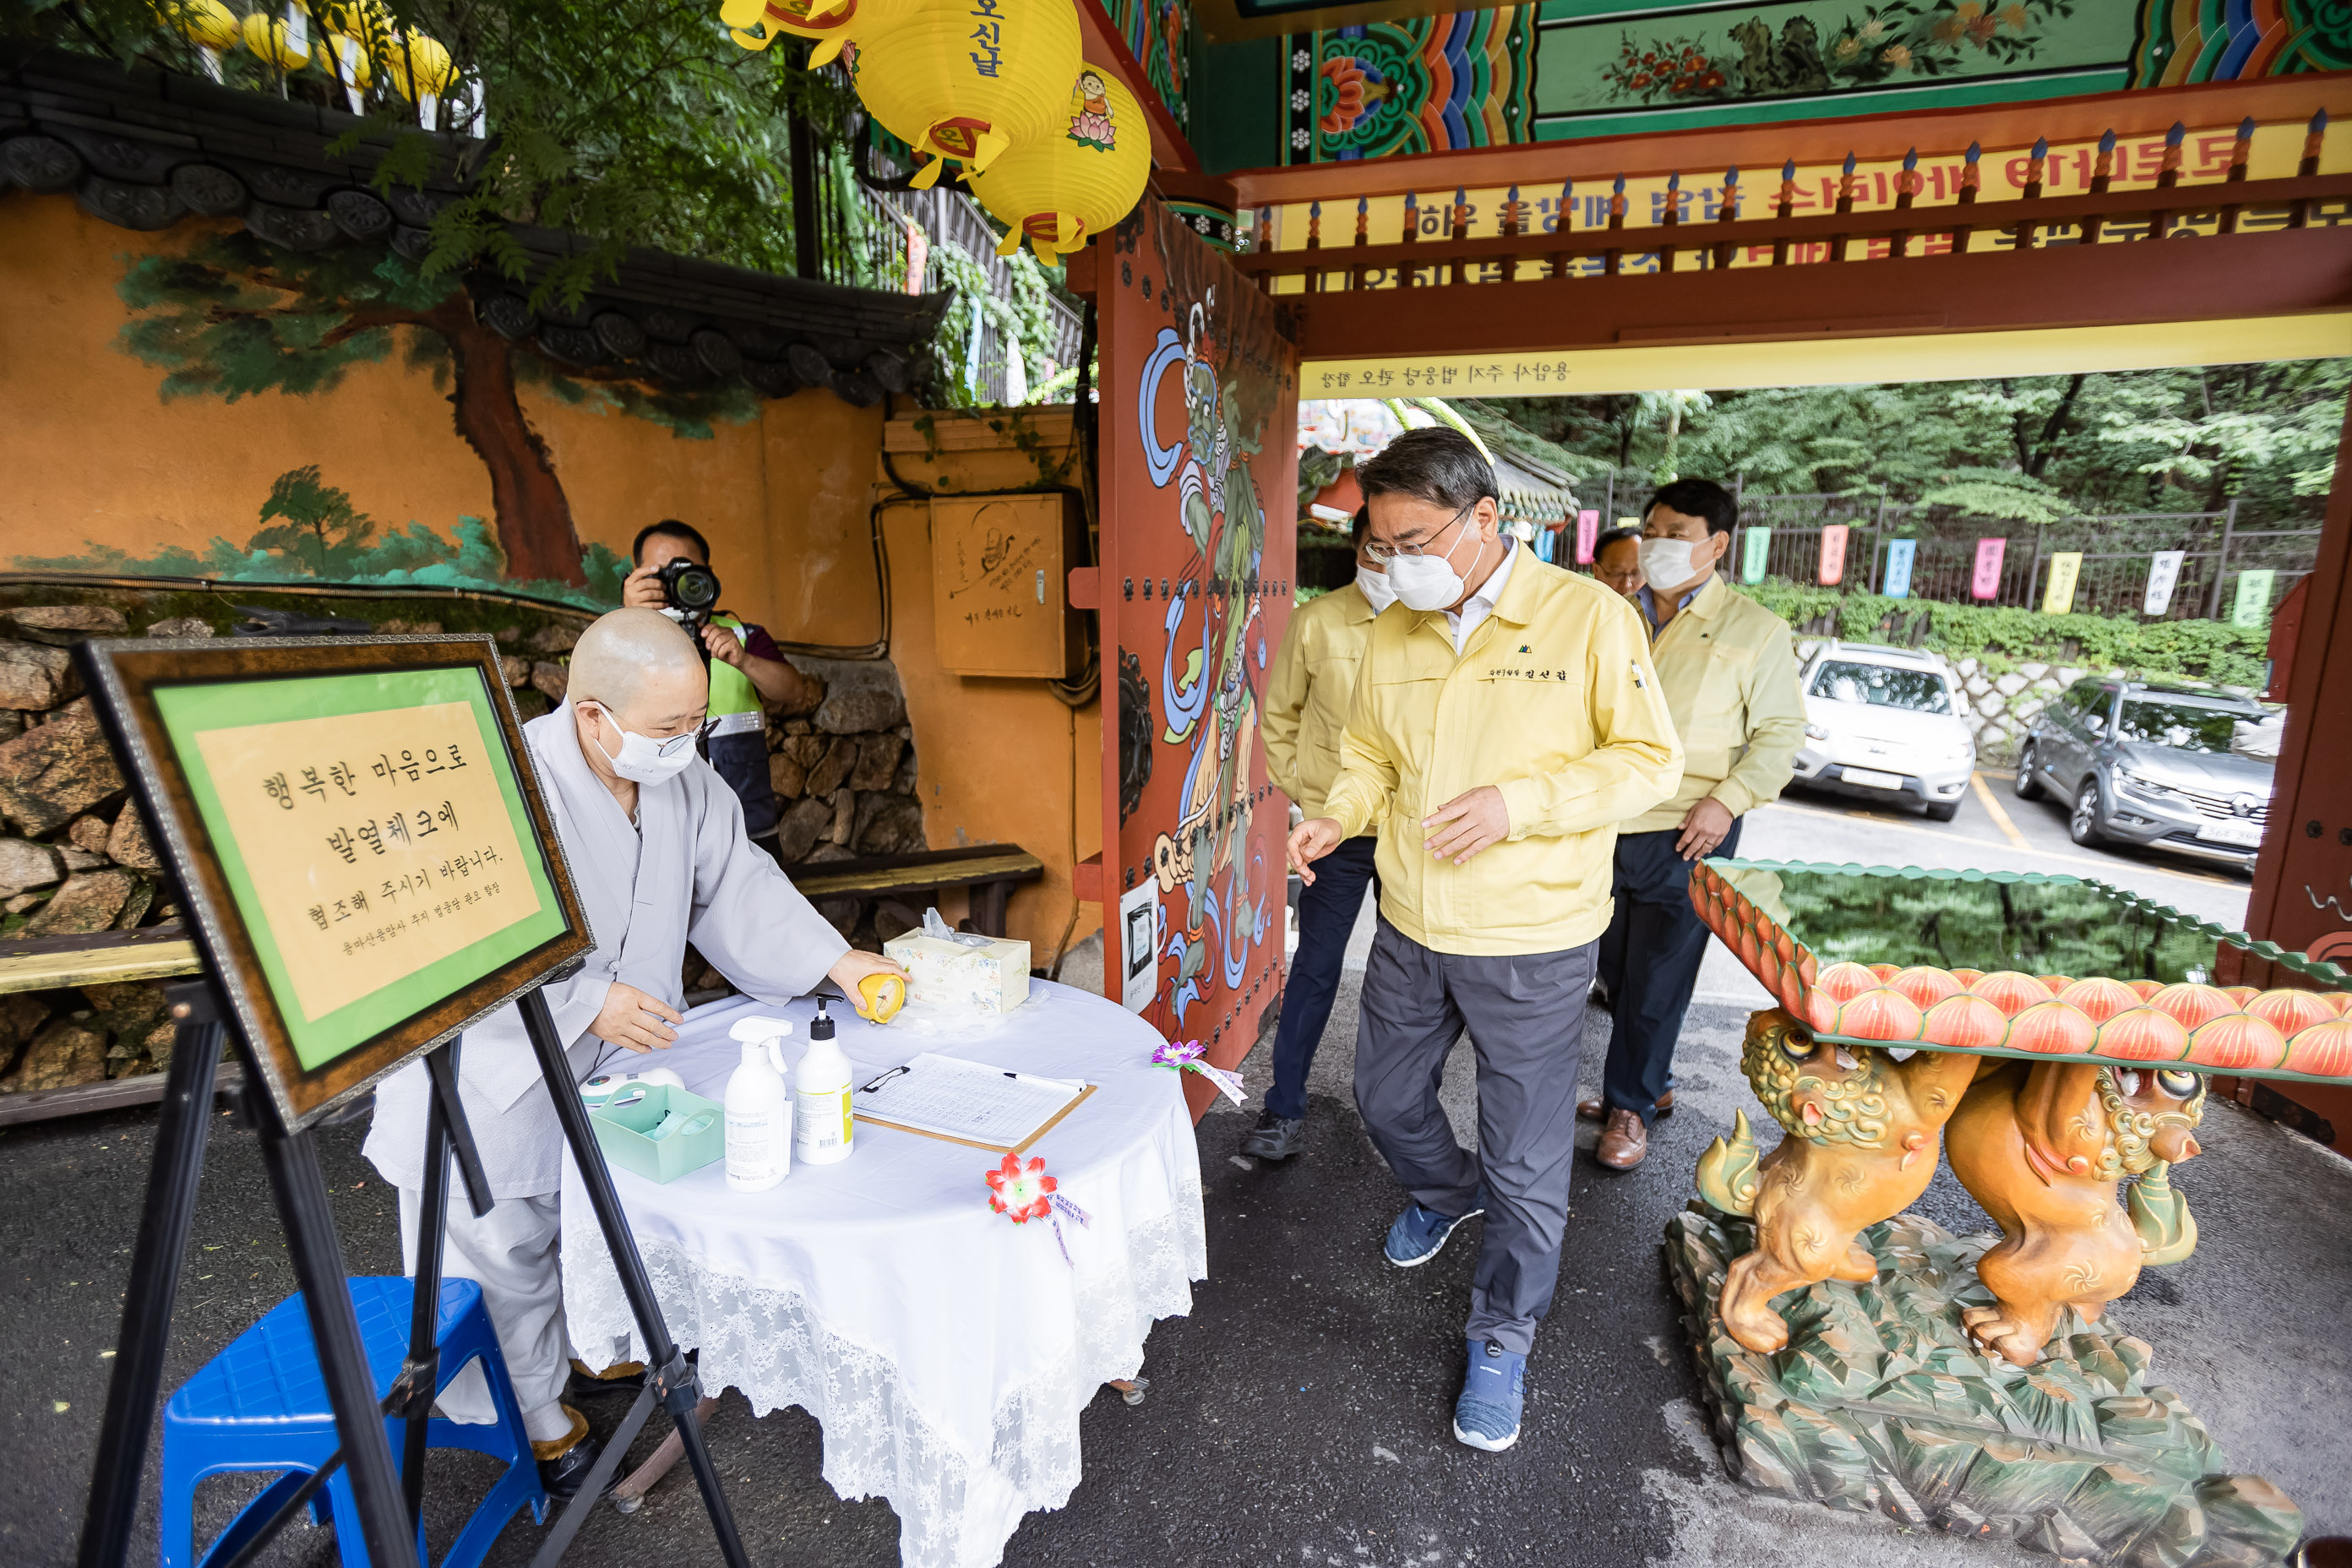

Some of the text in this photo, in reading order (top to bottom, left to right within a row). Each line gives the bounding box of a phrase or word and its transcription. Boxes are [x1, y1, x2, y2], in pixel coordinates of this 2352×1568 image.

[262, 743, 468, 810] 행복한 마음으로
[308, 845, 504, 931] 협조해 주시기 바랍니다.
[411, 910, 430, 927] 주지
[433, 897, 460, 918] 법웅당
[464, 890, 482, 906] 관오
[483, 881, 501, 897] 합장
